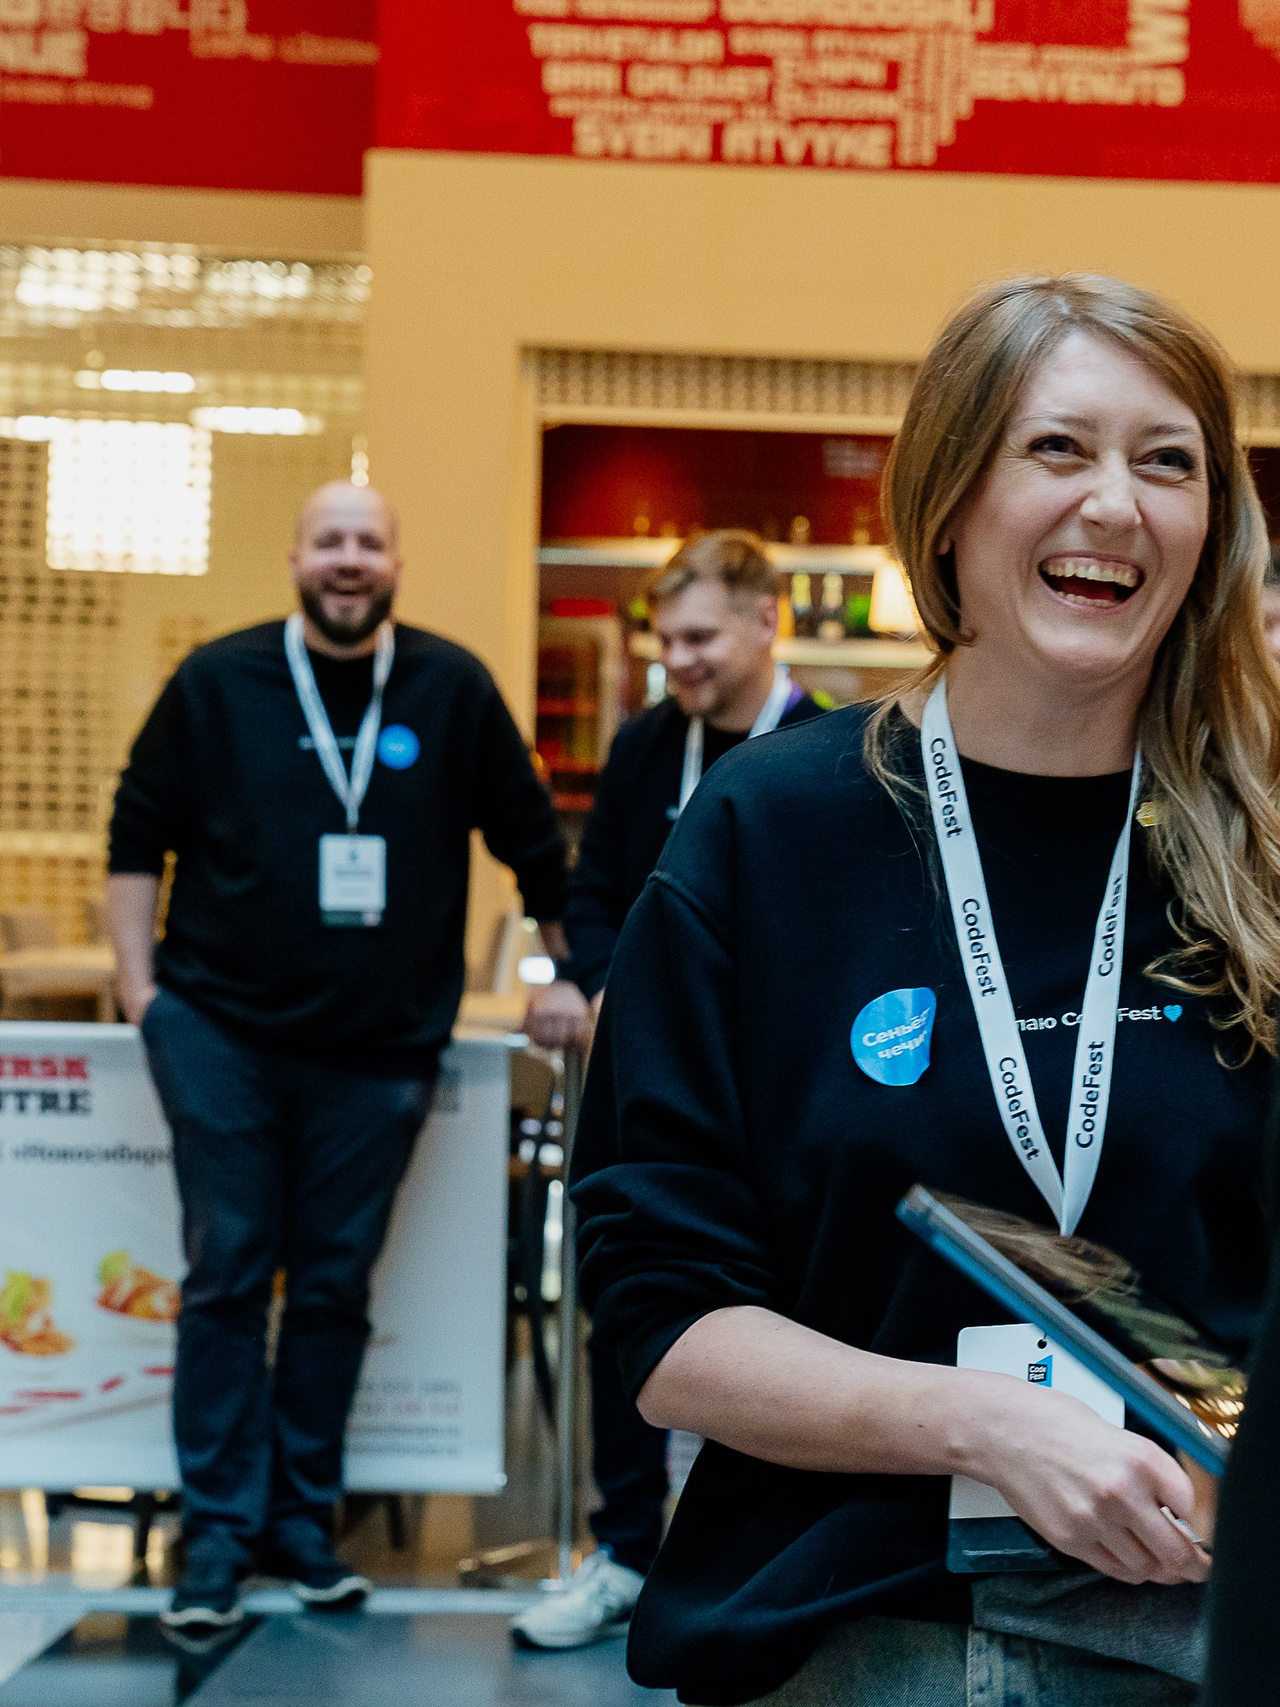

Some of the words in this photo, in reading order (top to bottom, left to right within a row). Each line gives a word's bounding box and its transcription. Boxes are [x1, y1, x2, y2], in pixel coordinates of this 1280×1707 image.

[930, 737, 964, 839] CodeFest
[962, 898, 998, 998] CodeFest
[1098, 873, 1124, 977] CodeFest
[1015, 1017, 1058, 1032] лаю
[0, 1054, 88, 1081] RSK
[1075, 1040, 1105, 1149] CodeFest
[0, 1088, 91, 1116] TRE
[999, 1056, 1041, 1161] CodeFest
[1029, 1365, 1047, 1373] Code
[1029, 1373, 1045, 1381] Fest
